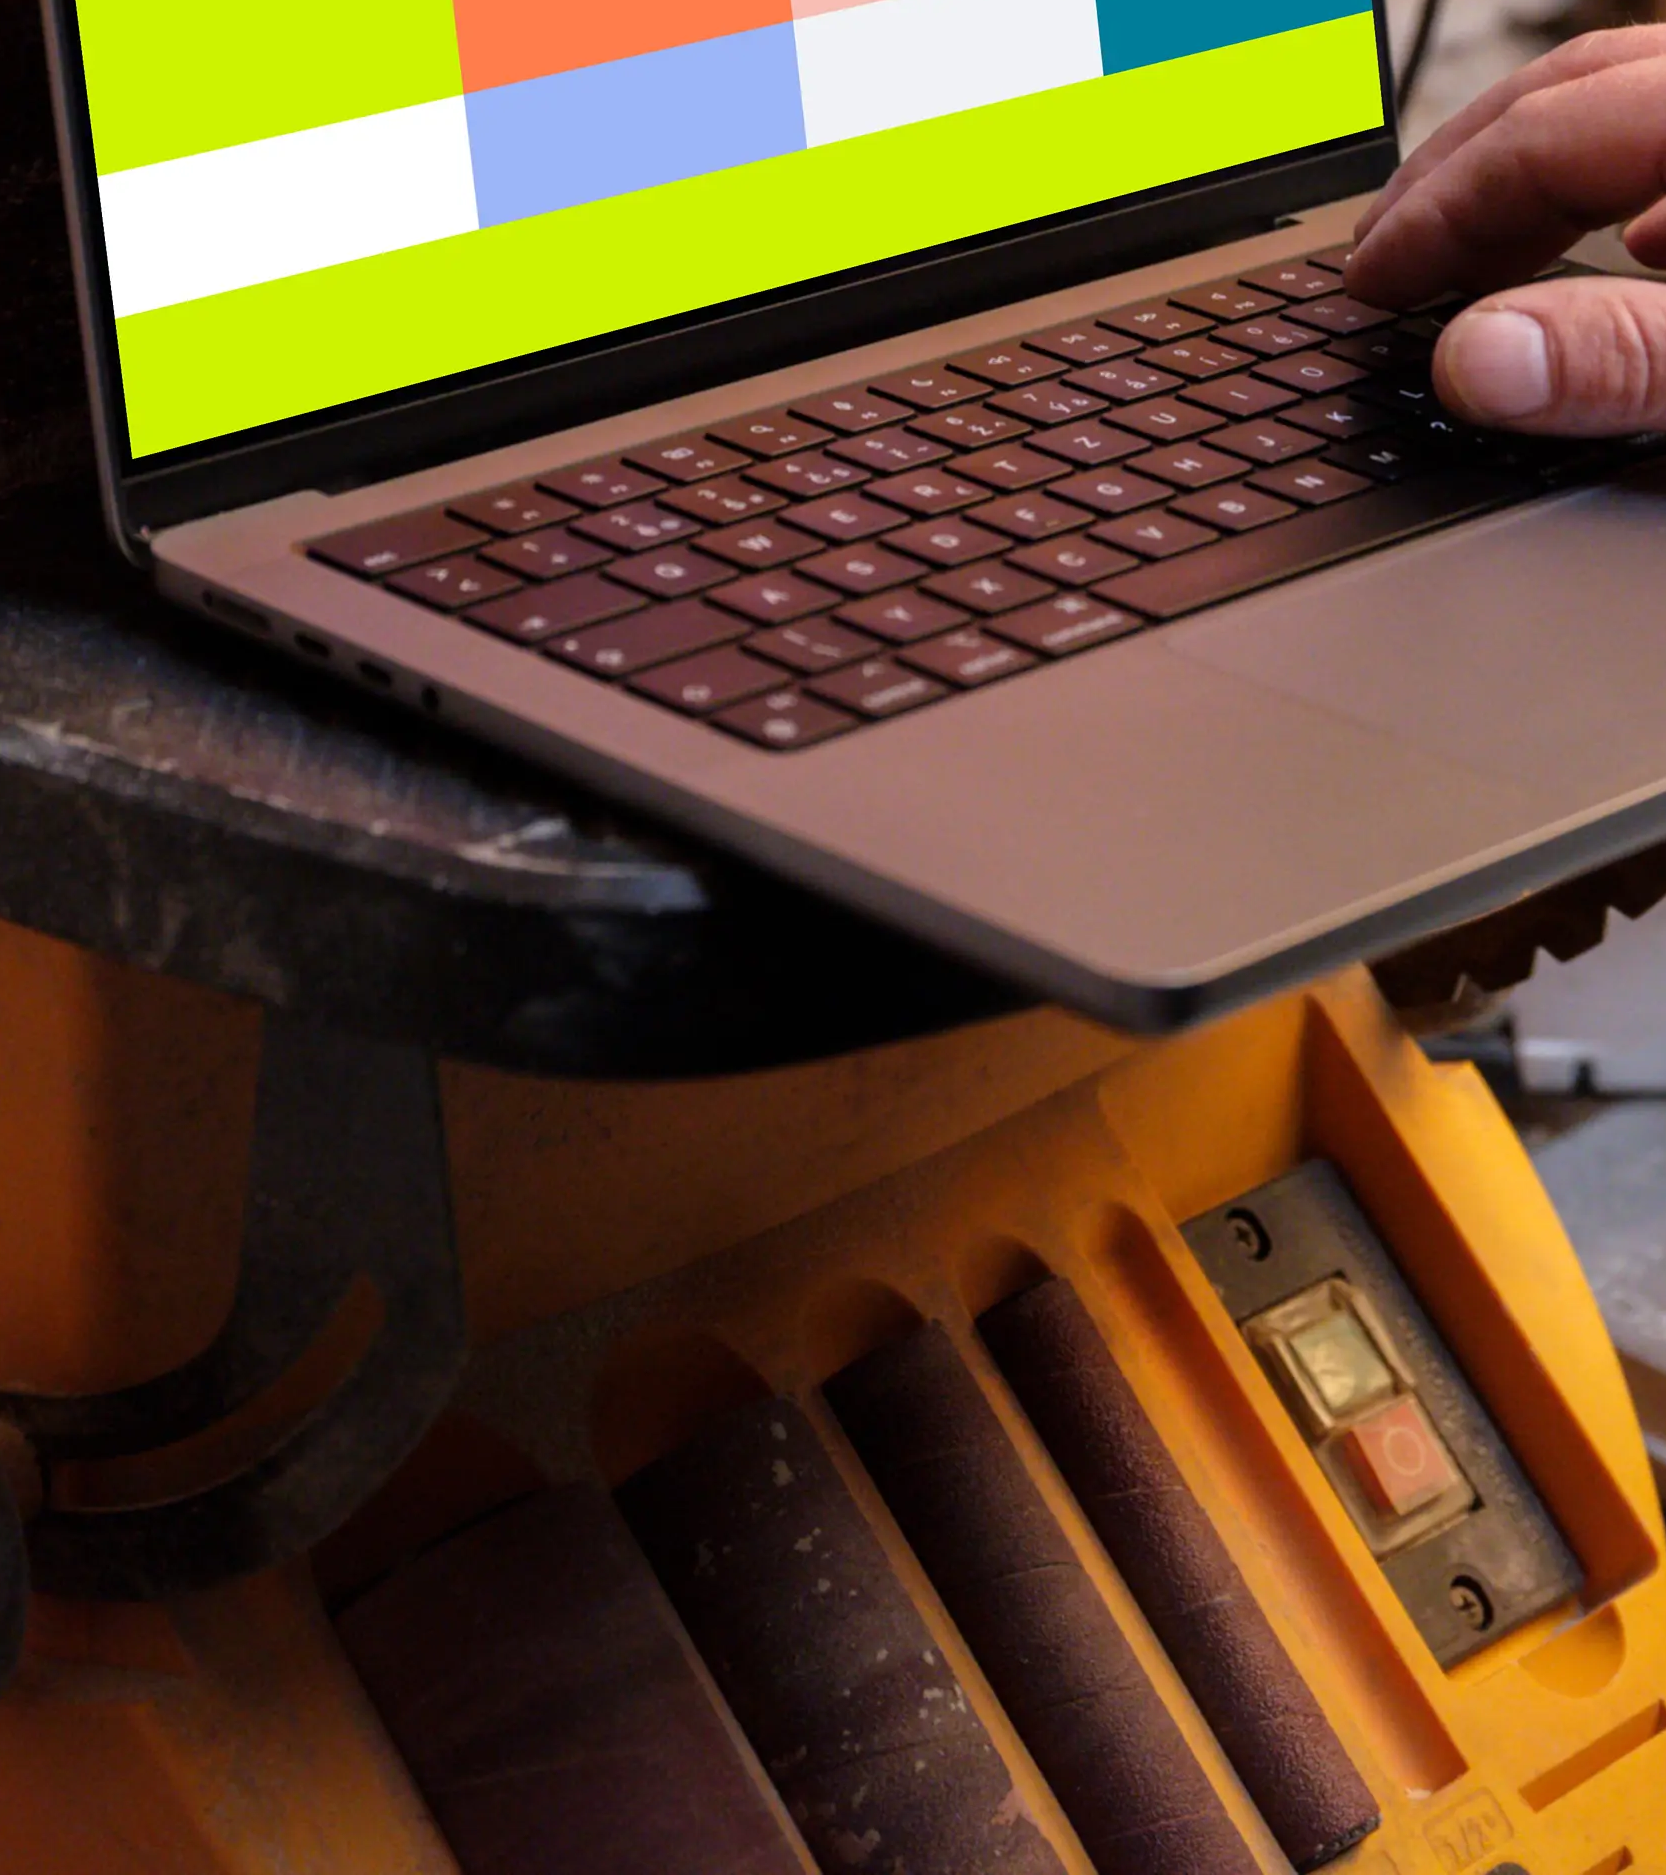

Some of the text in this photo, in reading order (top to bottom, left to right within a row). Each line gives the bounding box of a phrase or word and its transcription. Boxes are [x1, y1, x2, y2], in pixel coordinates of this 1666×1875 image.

[1300, 366, 1324, 377] O
[1229, 390, 1249, 400] I
[1398, 388, 1425, 399] L
[1149, 412, 1177, 424] U
[1325, 409, 1353, 424] K
[1073, 435, 1101, 449] Z
[1256, 435, 1276, 447] J
[993, 459, 1019, 473] T
[1173, 457, 1203, 471] H
[912, 484, 942, 498] R
[1096, 482, 1124, 496] G
[1015, 507, 1036, 522] F
[1136, 525, 1164, 540] V
[1056, 551, 1086, 568] C
[969, 577, 1003, 595] X
